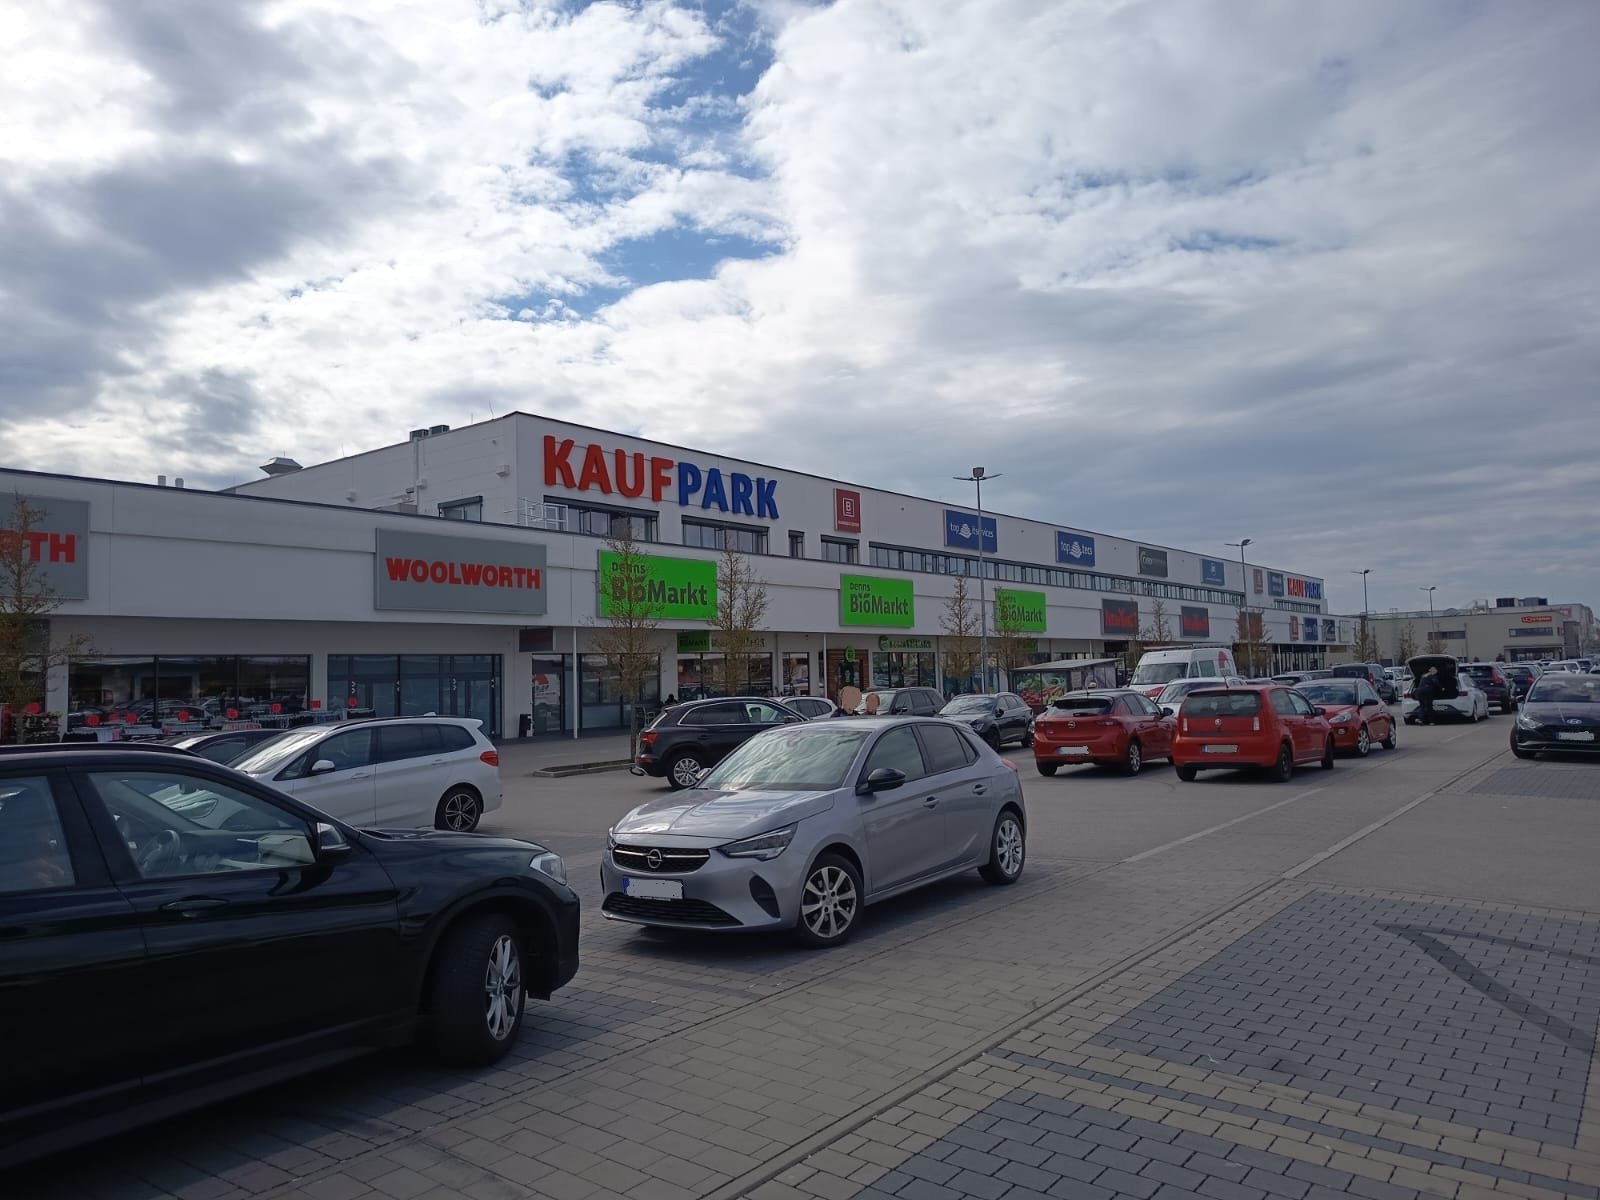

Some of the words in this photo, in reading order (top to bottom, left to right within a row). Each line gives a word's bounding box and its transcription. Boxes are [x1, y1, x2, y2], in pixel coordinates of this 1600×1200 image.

[543, 434, 779, 519] KAUFPARK
[385, 557, 541, 590] WOOLWORTH
[850, 593, 909, 615] BioMarkt
